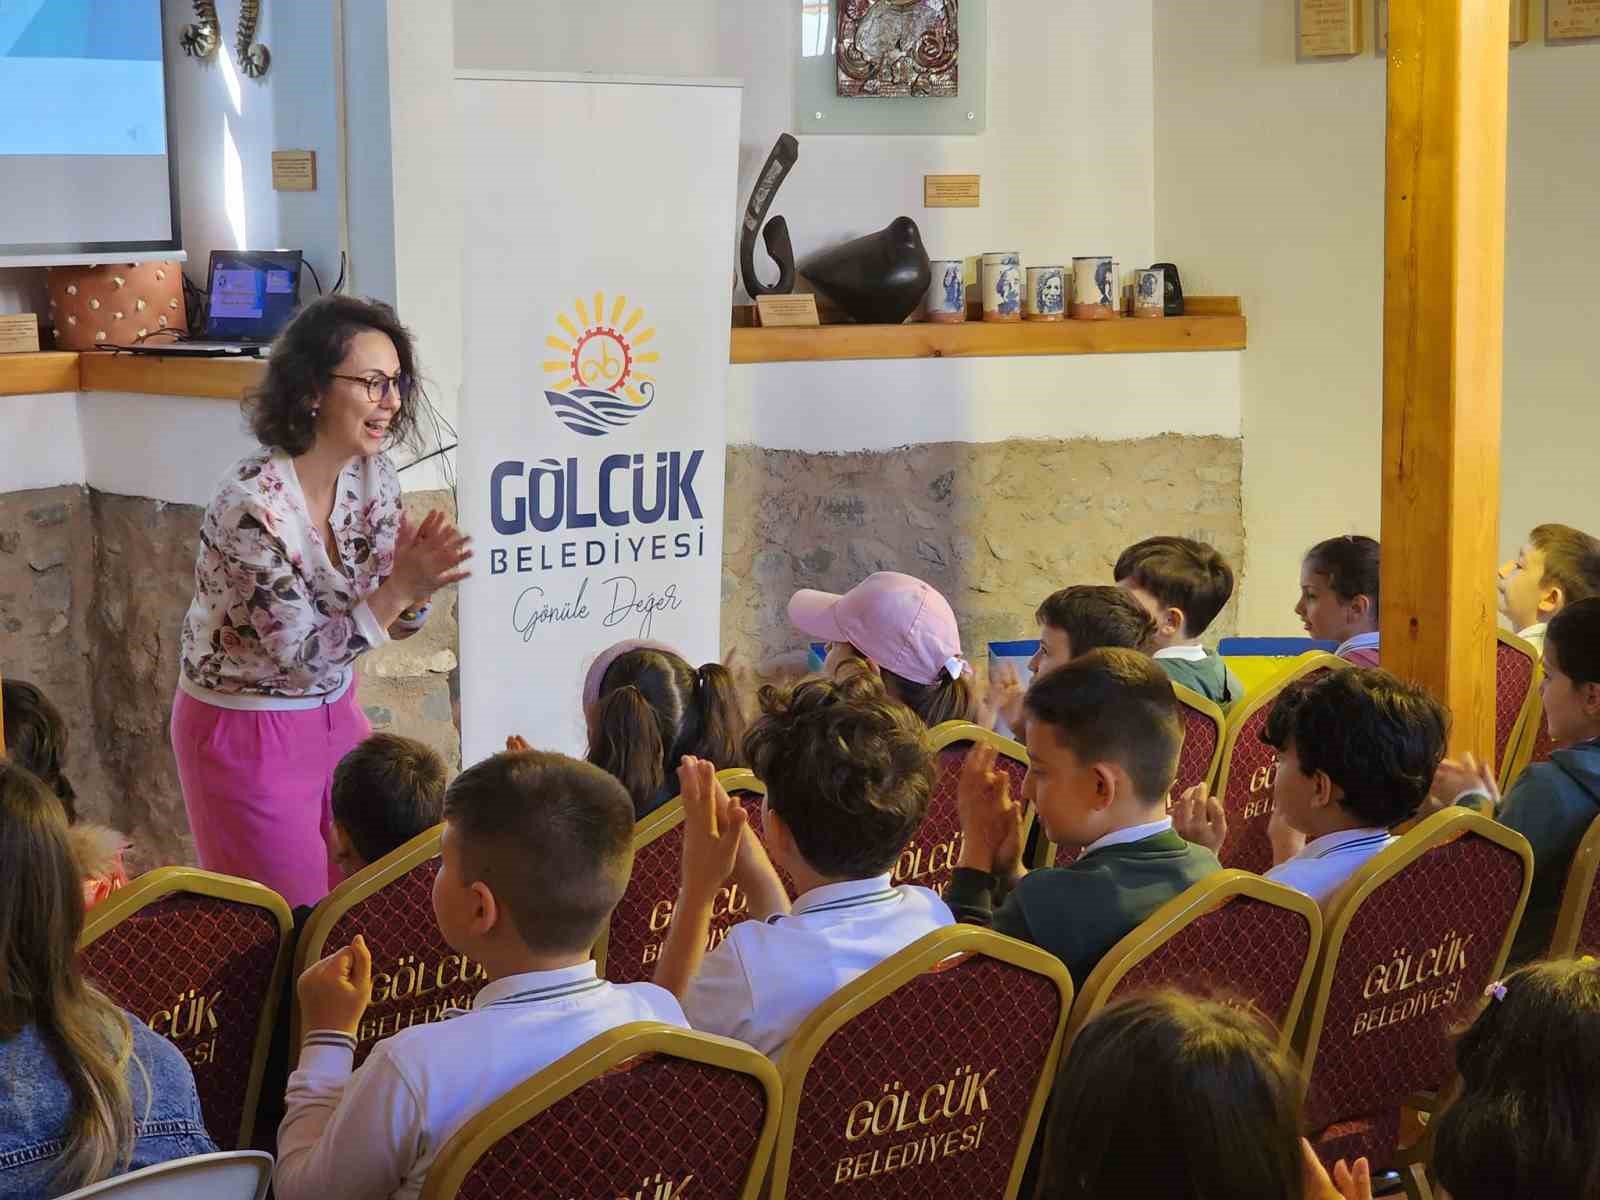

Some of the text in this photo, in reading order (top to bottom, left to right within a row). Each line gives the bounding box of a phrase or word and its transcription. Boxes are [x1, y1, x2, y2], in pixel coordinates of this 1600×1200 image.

[489, 449, 705, 536] GÖLCÜK
[489, 525, 705, 575] BELEDİYESİ
[511, 575, 683, 643] Gönüle Değer
[1363, 929, 1475, 1000] GÖLCÜK
[1351, 974, 1463, 1037] BELEDİYESİ
[845, 1064, 998, 1143] GÖLCÜK
[833, 1116, 986, 1185] BELEDİYESİ
